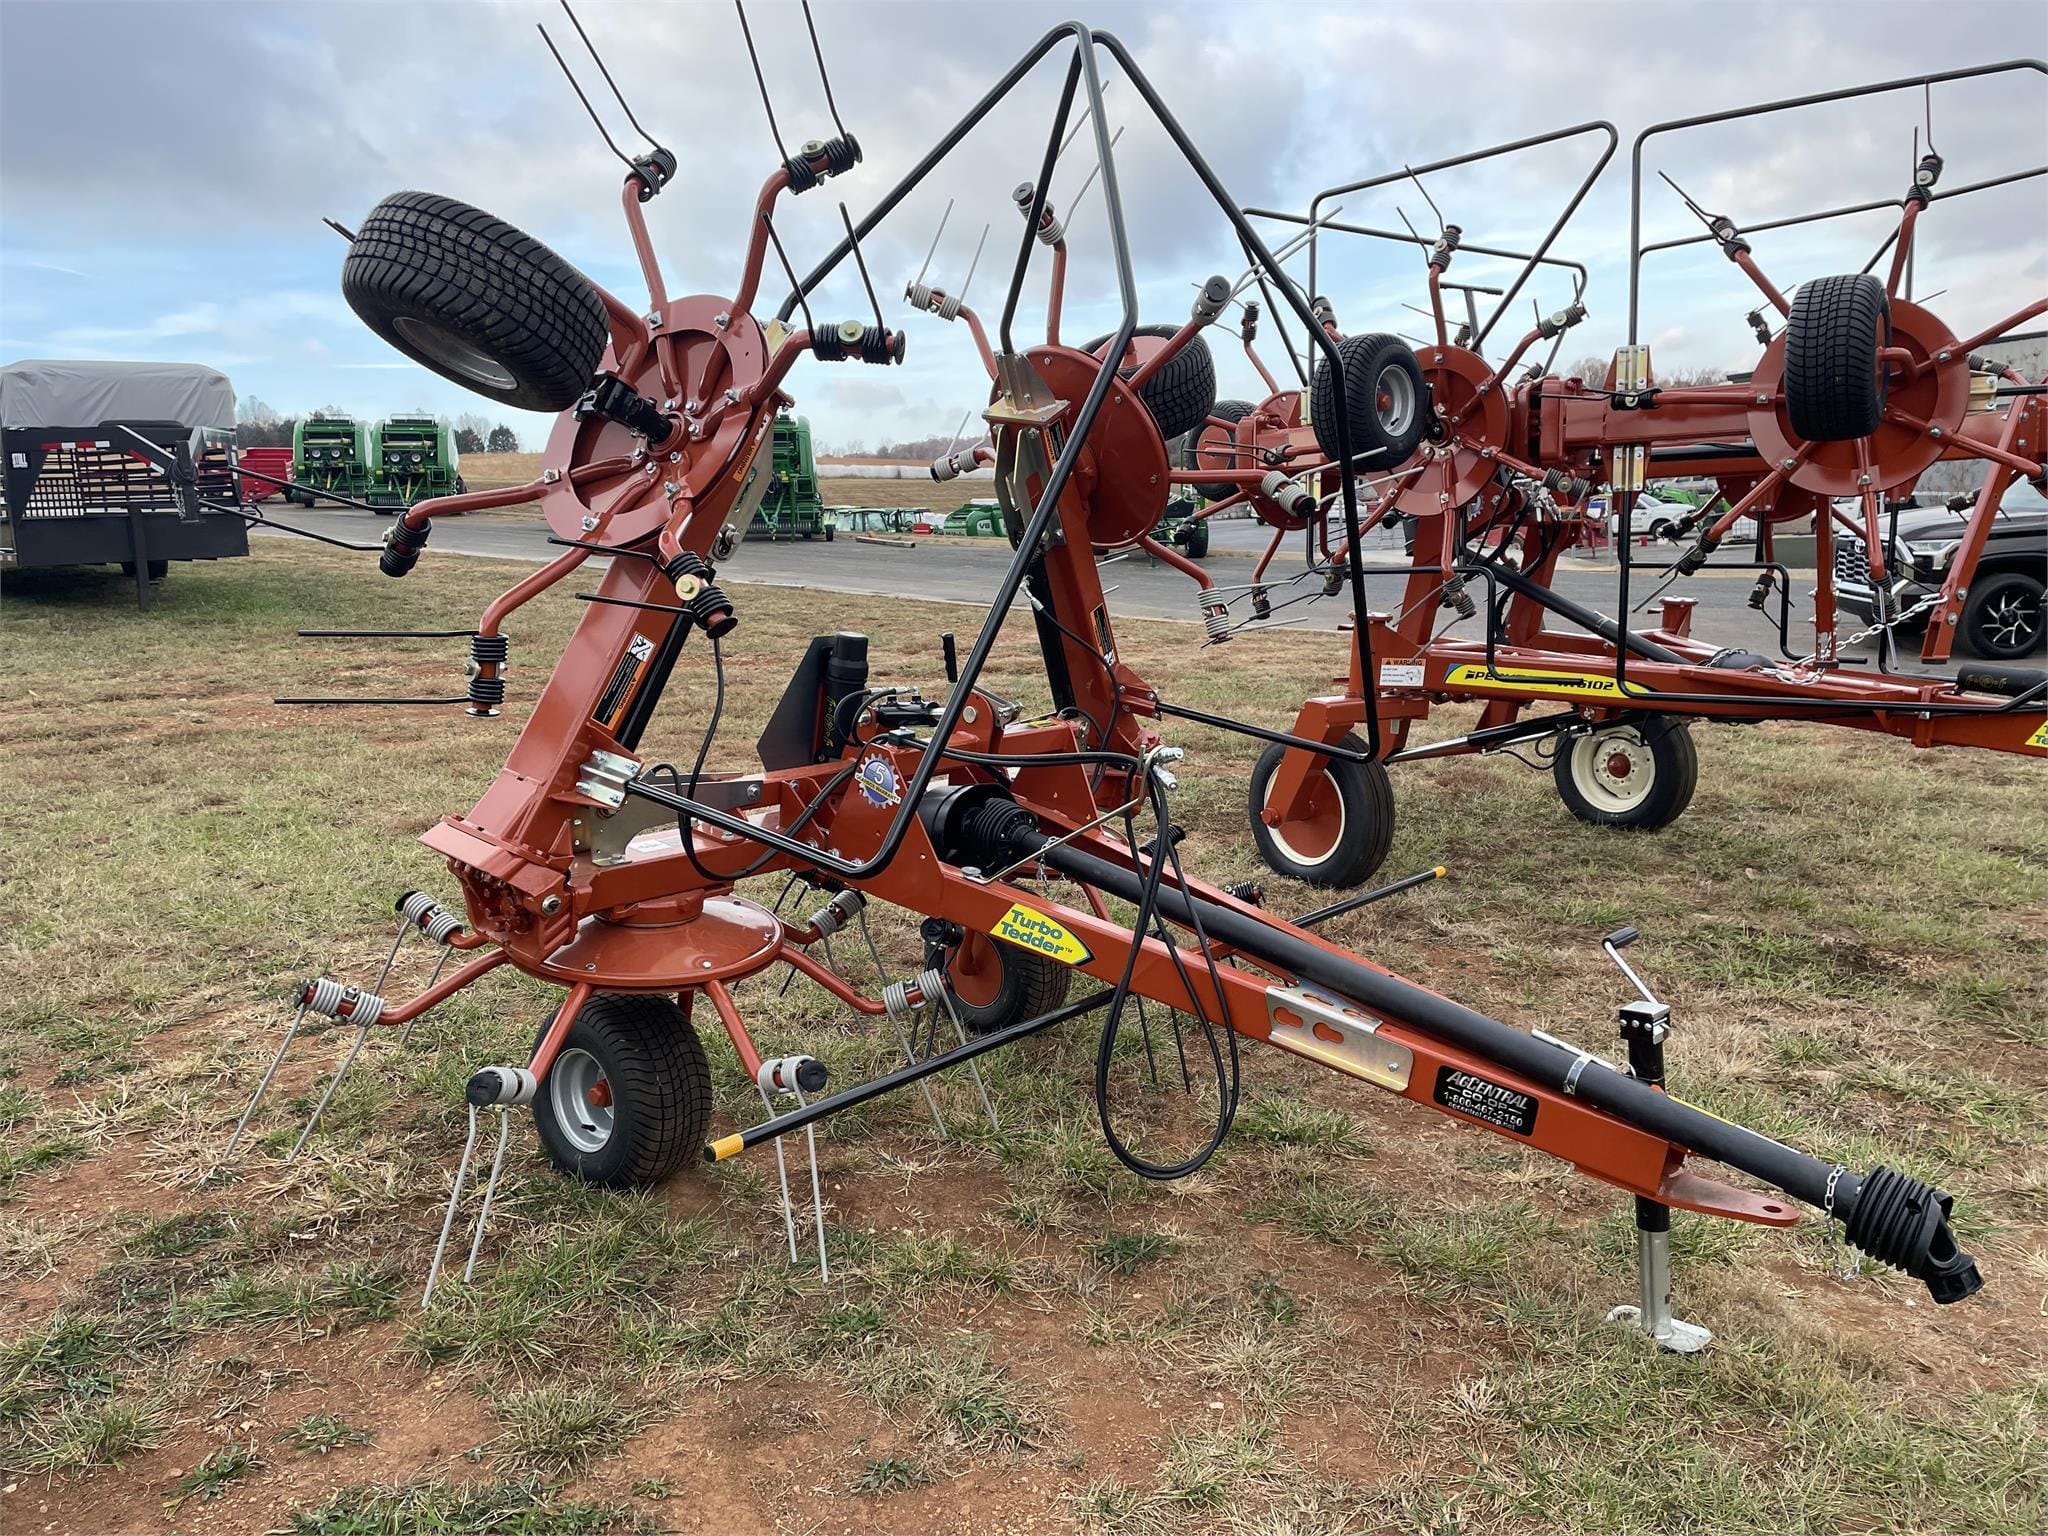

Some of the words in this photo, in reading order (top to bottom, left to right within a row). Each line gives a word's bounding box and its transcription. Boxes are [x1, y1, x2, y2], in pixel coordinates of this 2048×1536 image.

[874, 765, 886, 785] 5
[1010, 909, 1063, 940] Turbo
[1443, 1091, 1523, 1126] 1-800-467-2150
[1462, 1089, 1508, 1109] CO-OP
